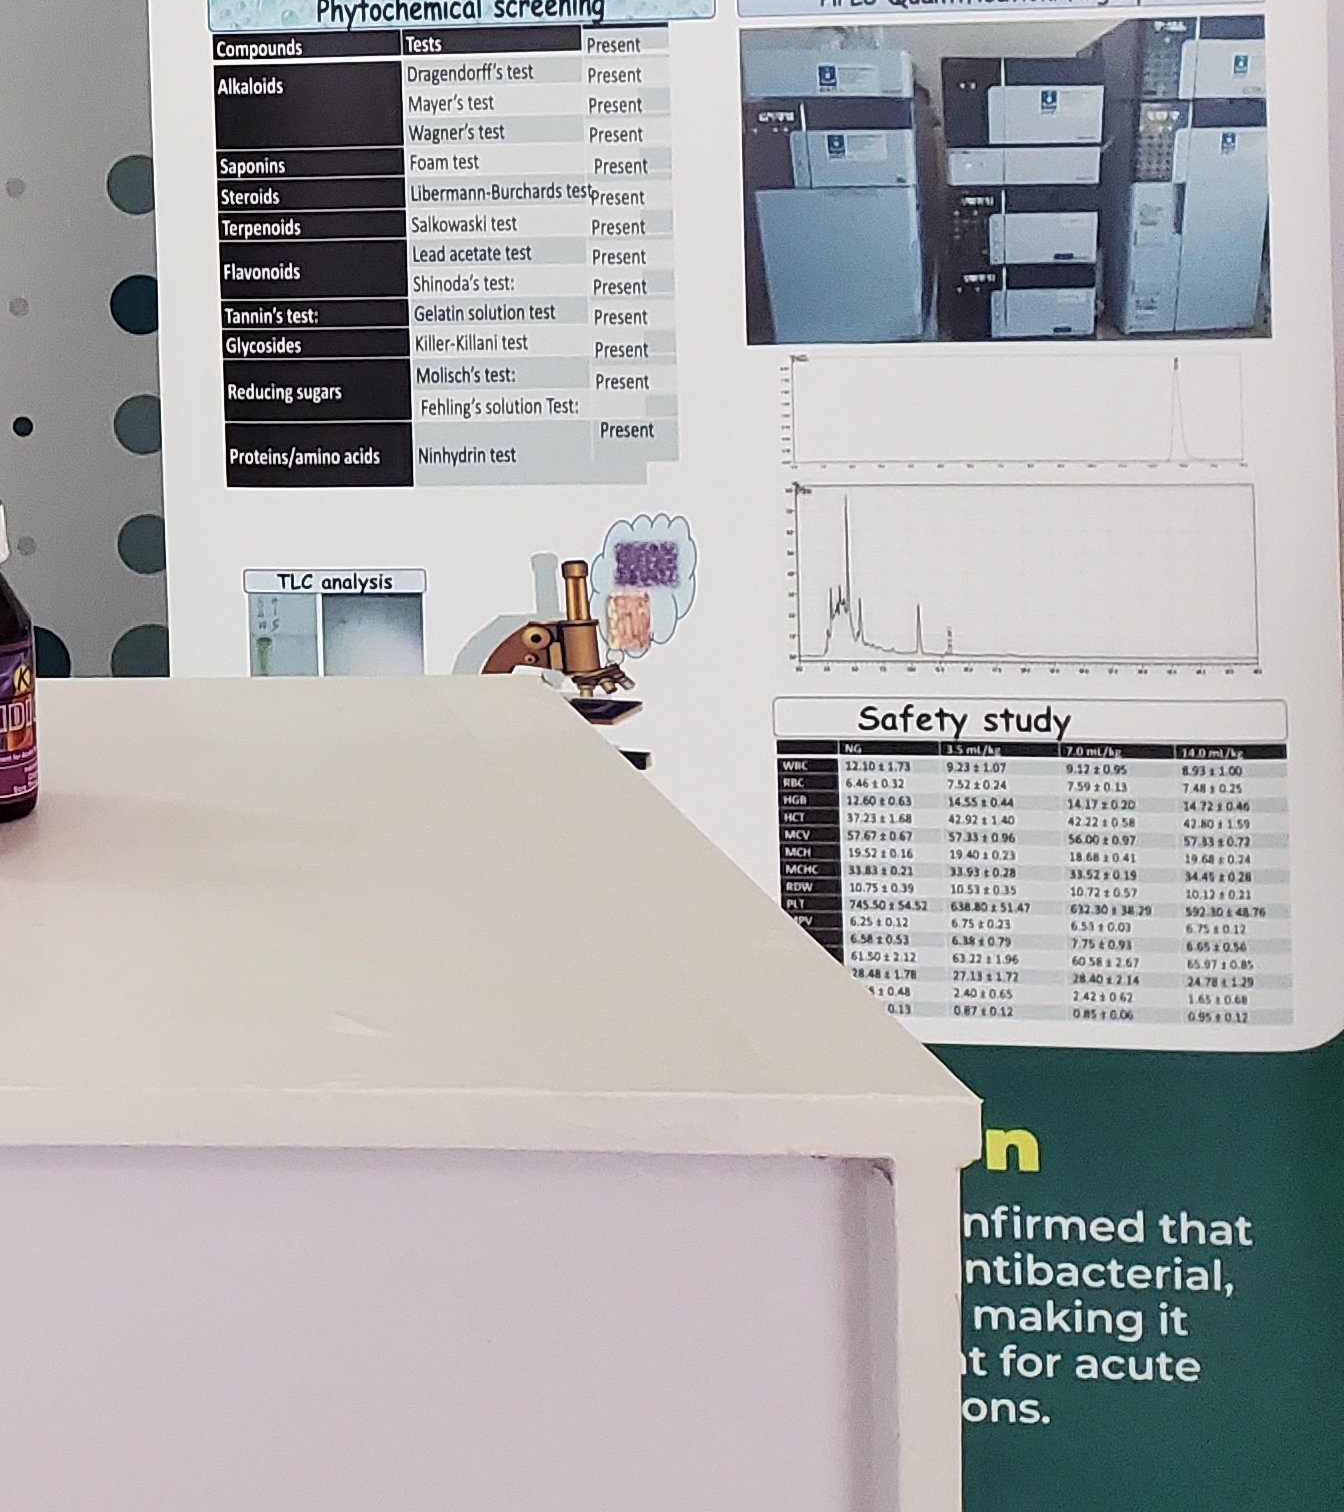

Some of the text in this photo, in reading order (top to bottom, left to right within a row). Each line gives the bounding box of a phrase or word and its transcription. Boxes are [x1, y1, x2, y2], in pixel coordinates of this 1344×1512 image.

[217, 39, 303, 59] Compounds
[406, 36, 441, 52] Tests
[588, 38, 640, 53] Present
[507, 64, 533, 79] test
[218, 77, 283, 95] Alkaloids
[220, 157, 285, 178] Saponins
[411, 154, 480, 170] Foam test
[220, 220, 302, 240] Terpenoids
[224, 263, 300, 280] Flavonoids
[226, 337, 301, 357] Glycosides
[277, 573, 396, 598] TLC analysis
[858, 704, 1071, 741] Safety study
[1159, 1211, 1252, 1245] that
[974, 1299, 1188, 1342] making it
[1000, 1345, 1061, 1377] for
[1076, 1352, 1200, 1381] acute
